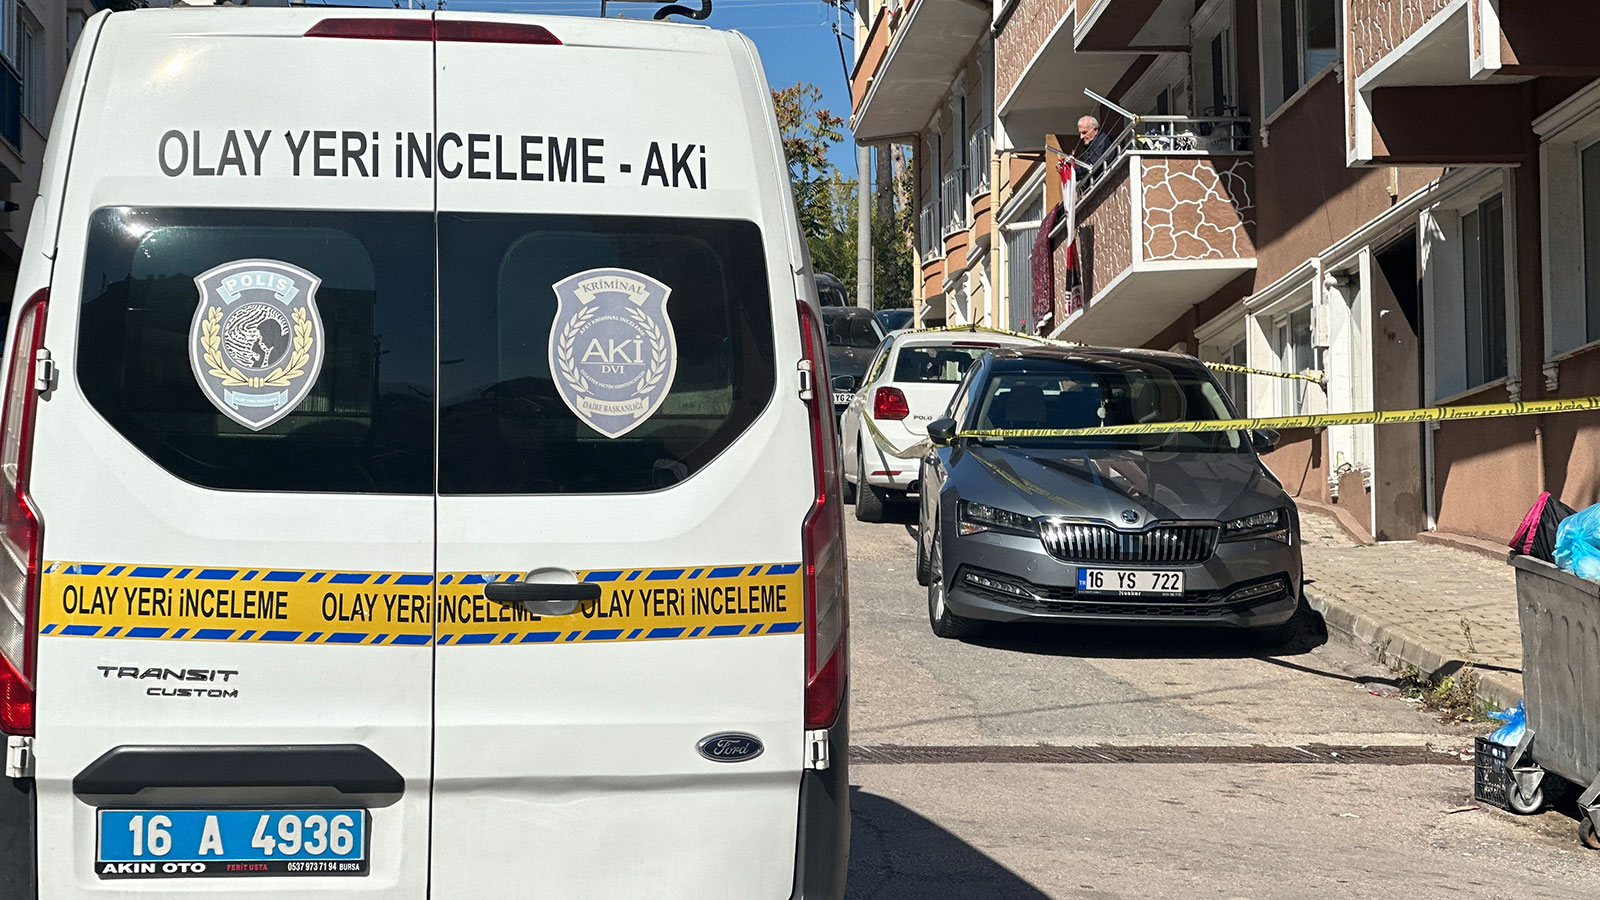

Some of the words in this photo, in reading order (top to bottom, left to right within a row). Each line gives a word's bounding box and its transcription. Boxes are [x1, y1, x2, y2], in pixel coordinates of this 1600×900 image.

[158, 129, 272, 177] OLAY
[228, 273, 288, 292] POLİS
[582, 279, 644, 295] KRİMİNAL
[580, 334, 645, 363] AKİ
[601, 365, 625, 374] DVI
[1088, 571, 1104, 588] 16
[1117, 572, 1136, 589] YS
[1151, 573, 1180, 590] 722
[62, 585, 119, 615] OLAY
[321, 591, 379, 623] OLAY
[96, 665, 239, 682] TRANSIT
[146, 687, 239, 698] CUSTOM
[713, 739, 751, 756] Ford
[129, 814, 173, 856] 16
[198, 815, 224, 856] A
[251, 814, 354, 856] 4936
[102, 863, 156, 874] AKIN
[162, 862, 206, 873] OTO
[287, 862, 305, 871] 0537
[305, 862, 319, 871] 973
[319, 862, 328, 871] 71
[328, 862, 337, 871] 94
[339, 863, 360, 871] BURSA
